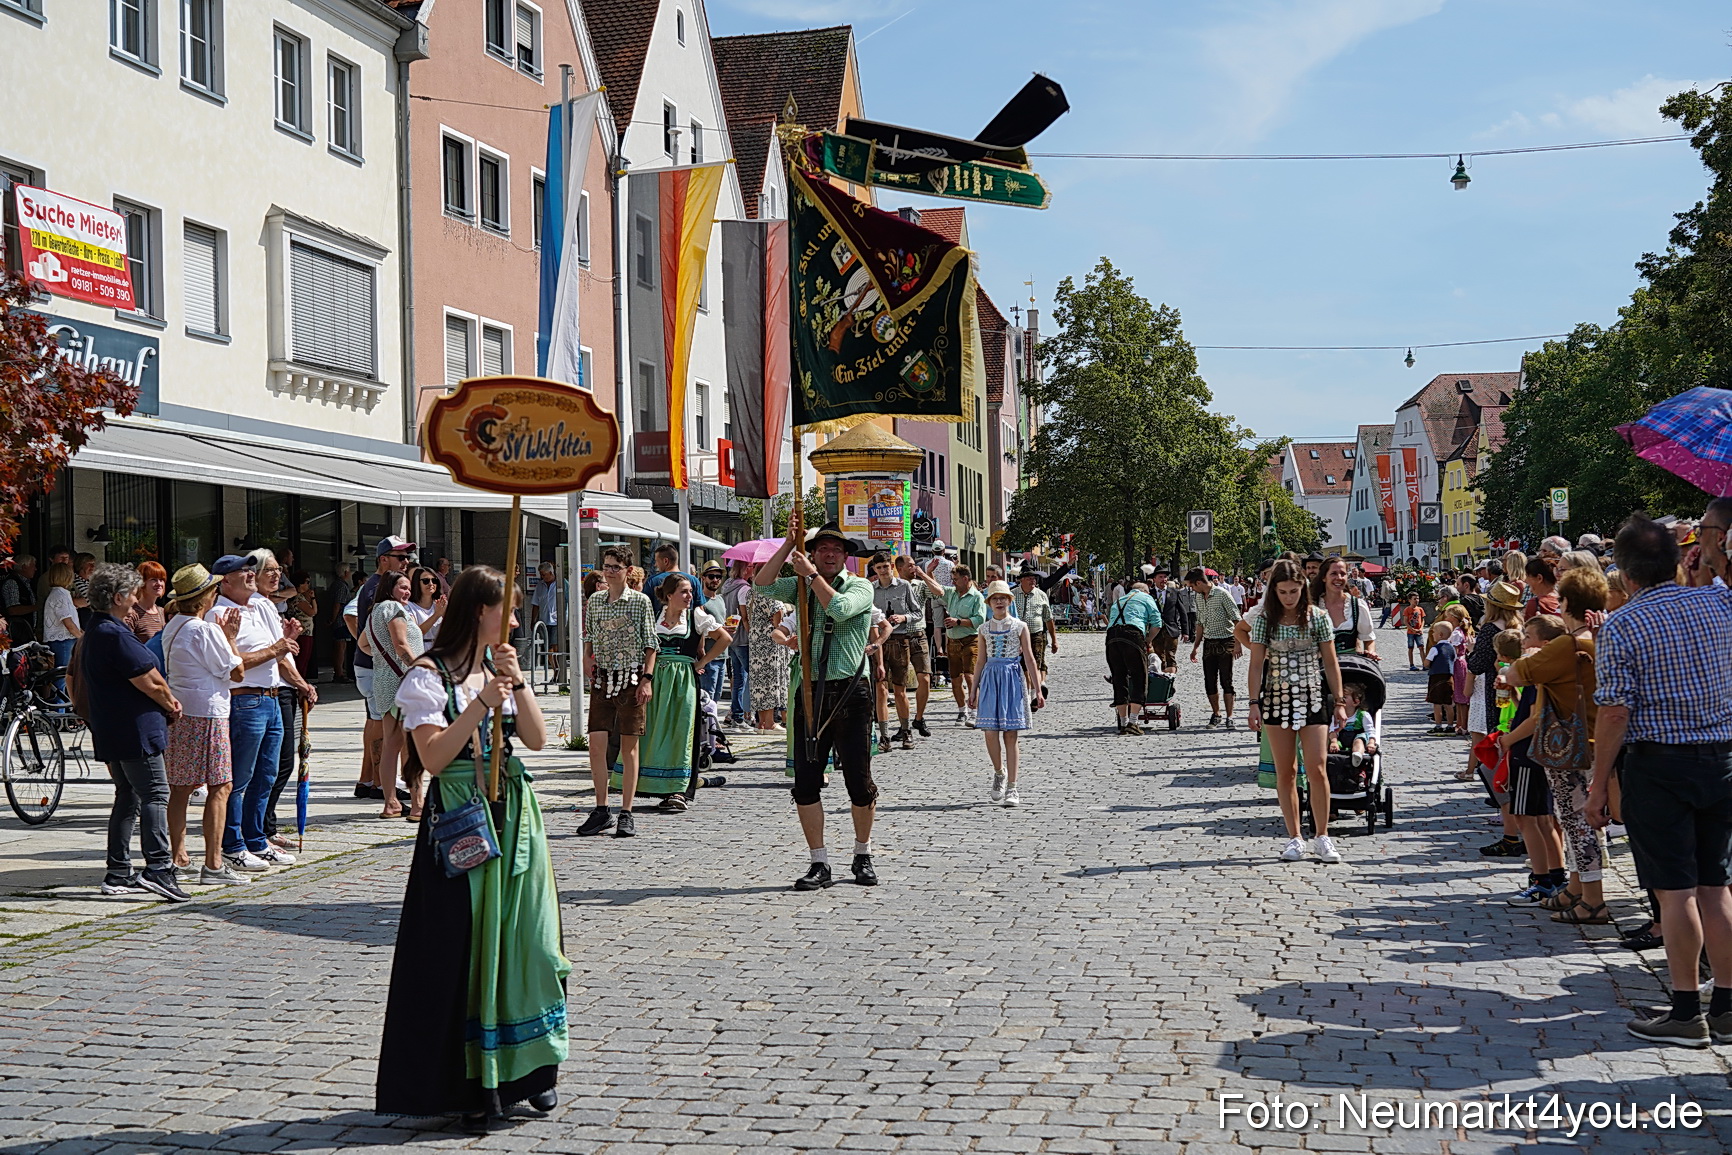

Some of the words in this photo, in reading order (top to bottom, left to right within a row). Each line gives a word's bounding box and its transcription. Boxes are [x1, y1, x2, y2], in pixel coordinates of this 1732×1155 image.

[23, 197, 75, 229] Suche
[79, 211, 123, 245] Mieter!
[818, 222, 834, 241] un
[71, 277, 93, 293] 09181
[99, 284, 115, 298] 509
[116, 287, 131, 302] 390
[855, 348, 885, 379] Ziel
[525, 420, 592, 463] Wolfstein
[1405, 470, 1420, 503] SALE
[871, 506, 903, 517] VOLKSFEST
